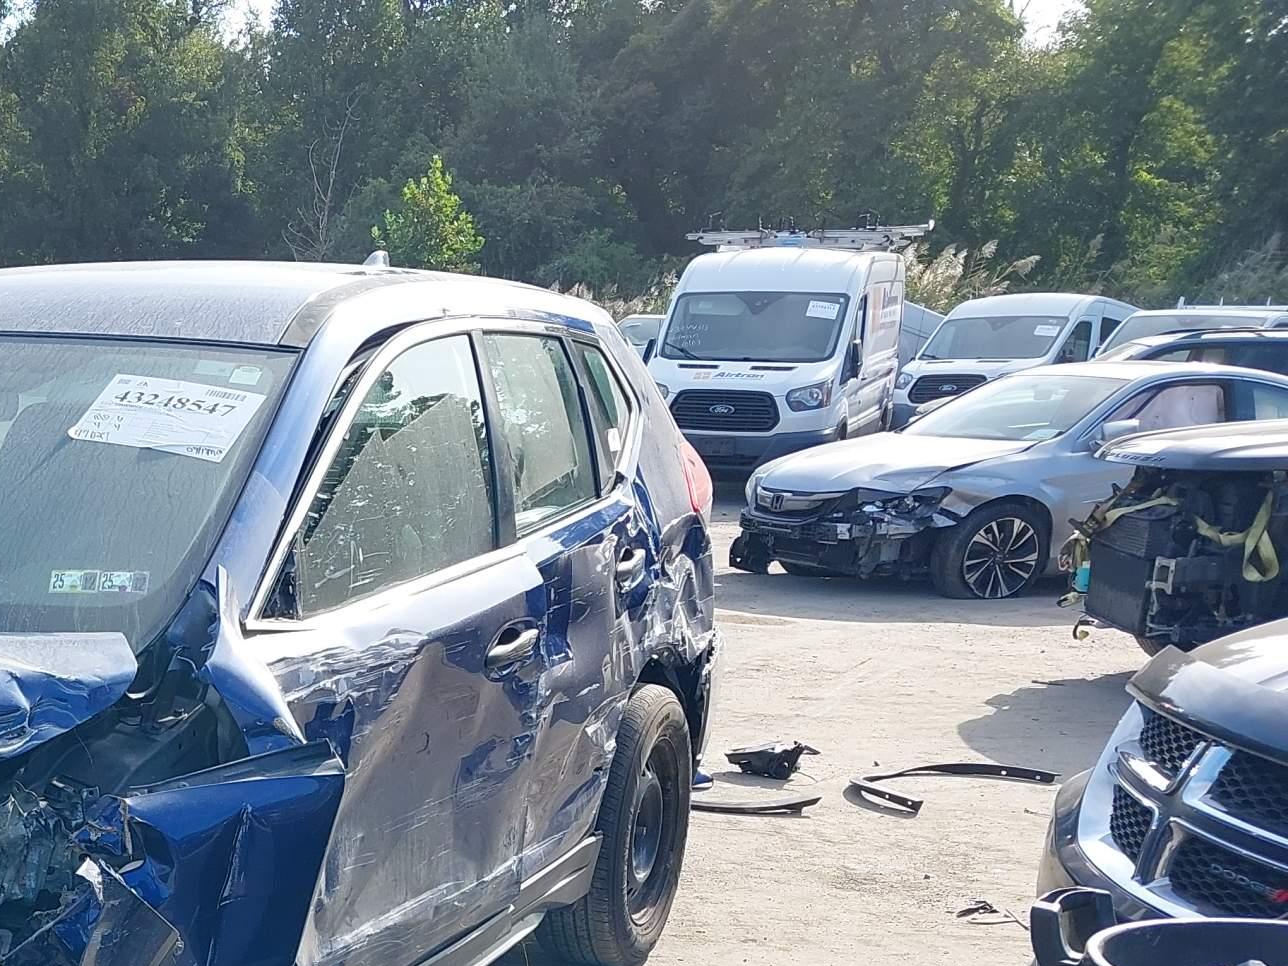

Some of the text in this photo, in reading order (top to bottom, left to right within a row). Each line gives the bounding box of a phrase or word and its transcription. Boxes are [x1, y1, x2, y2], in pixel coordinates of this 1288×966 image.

[713, 371, 765, 379] Airtron
[114, 390, 238, 418] 43248547
[52, 573, 66, 590] 25
[101, 573, 114, 590] 25
